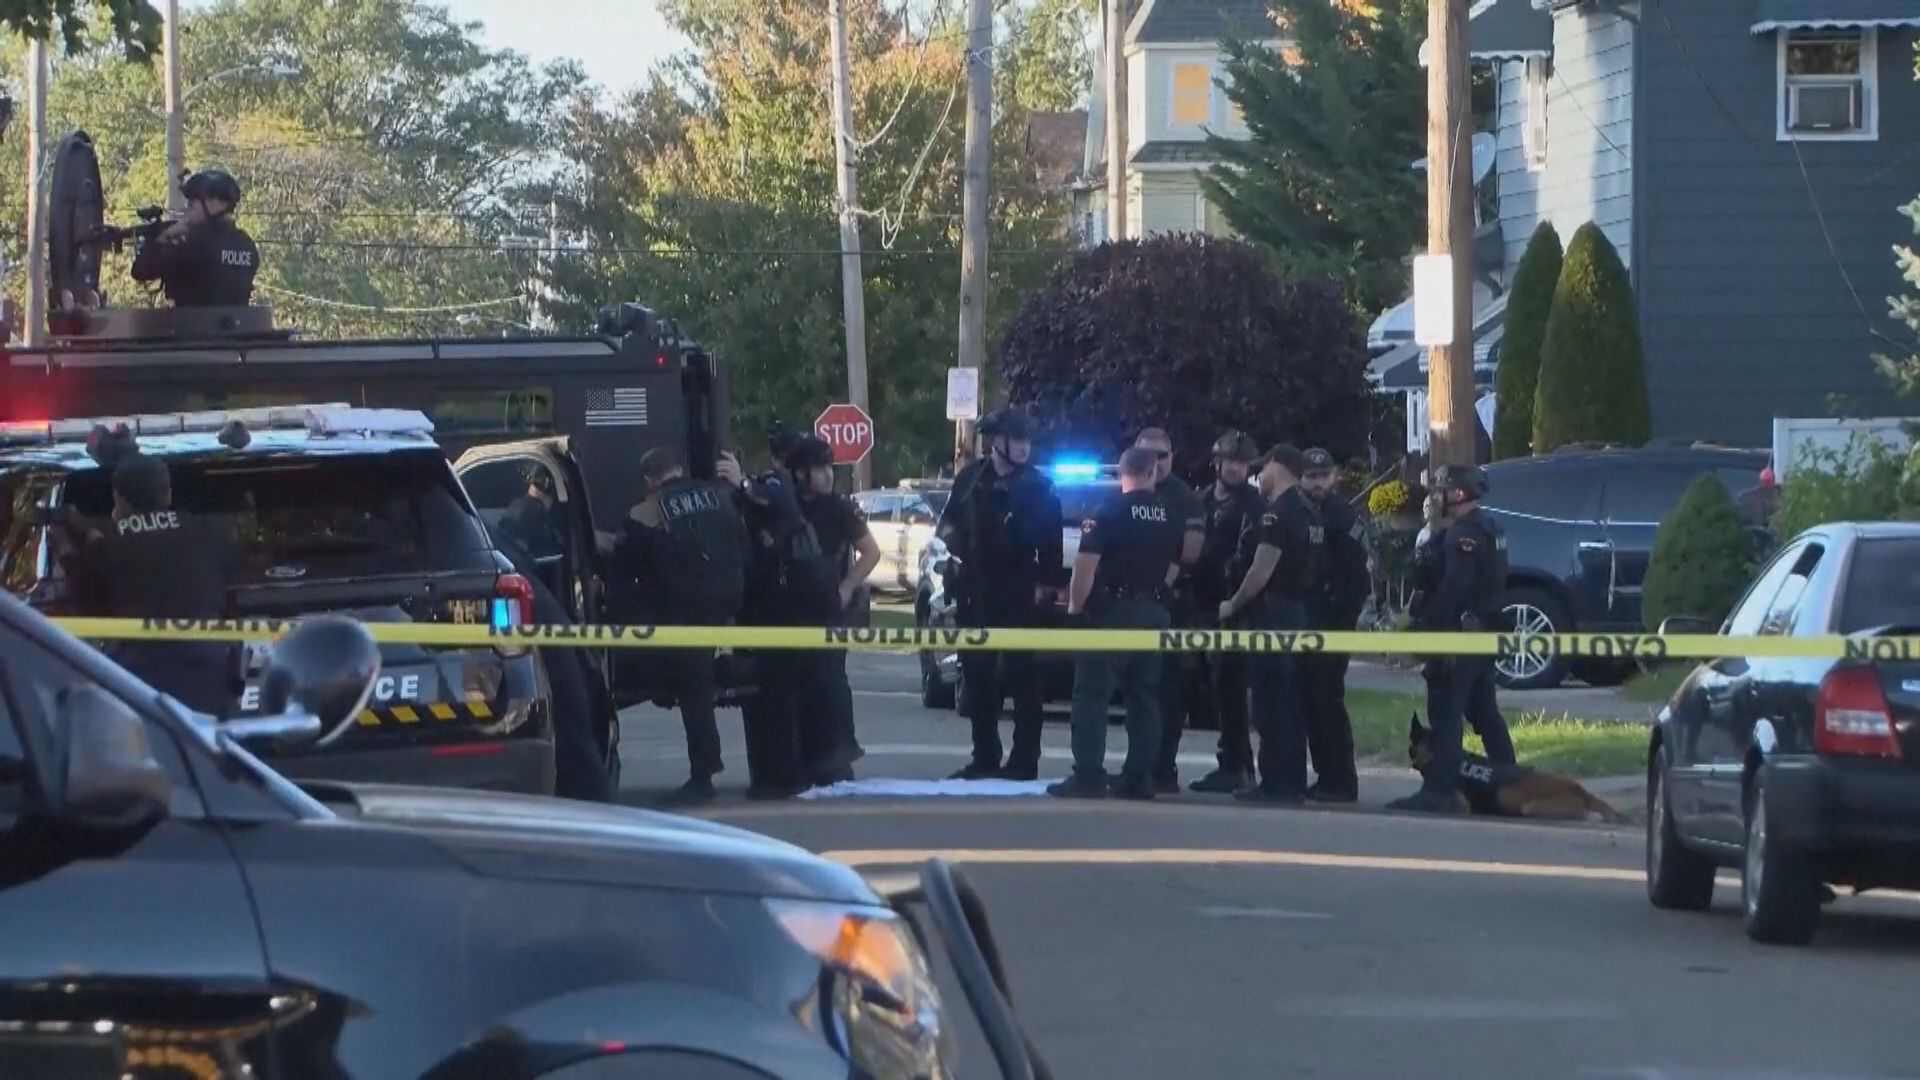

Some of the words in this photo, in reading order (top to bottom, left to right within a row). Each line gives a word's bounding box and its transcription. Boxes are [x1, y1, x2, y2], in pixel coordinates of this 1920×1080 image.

[220, 249, 252, 266] POLICE
[819, 422, 869, 445] STOP
[118, 511, 180, 536] POLICE
[1131, 505, 1167, 522] POLICE
[142, 617, 290, 632] AUTION
[824, 627, 989, 645] CAUTION
[1158, 631, 1325, 651] CAUTION
[1497, 635, 1667, 656] CAUTION
[1460, 761, 1494, 783] LICE
